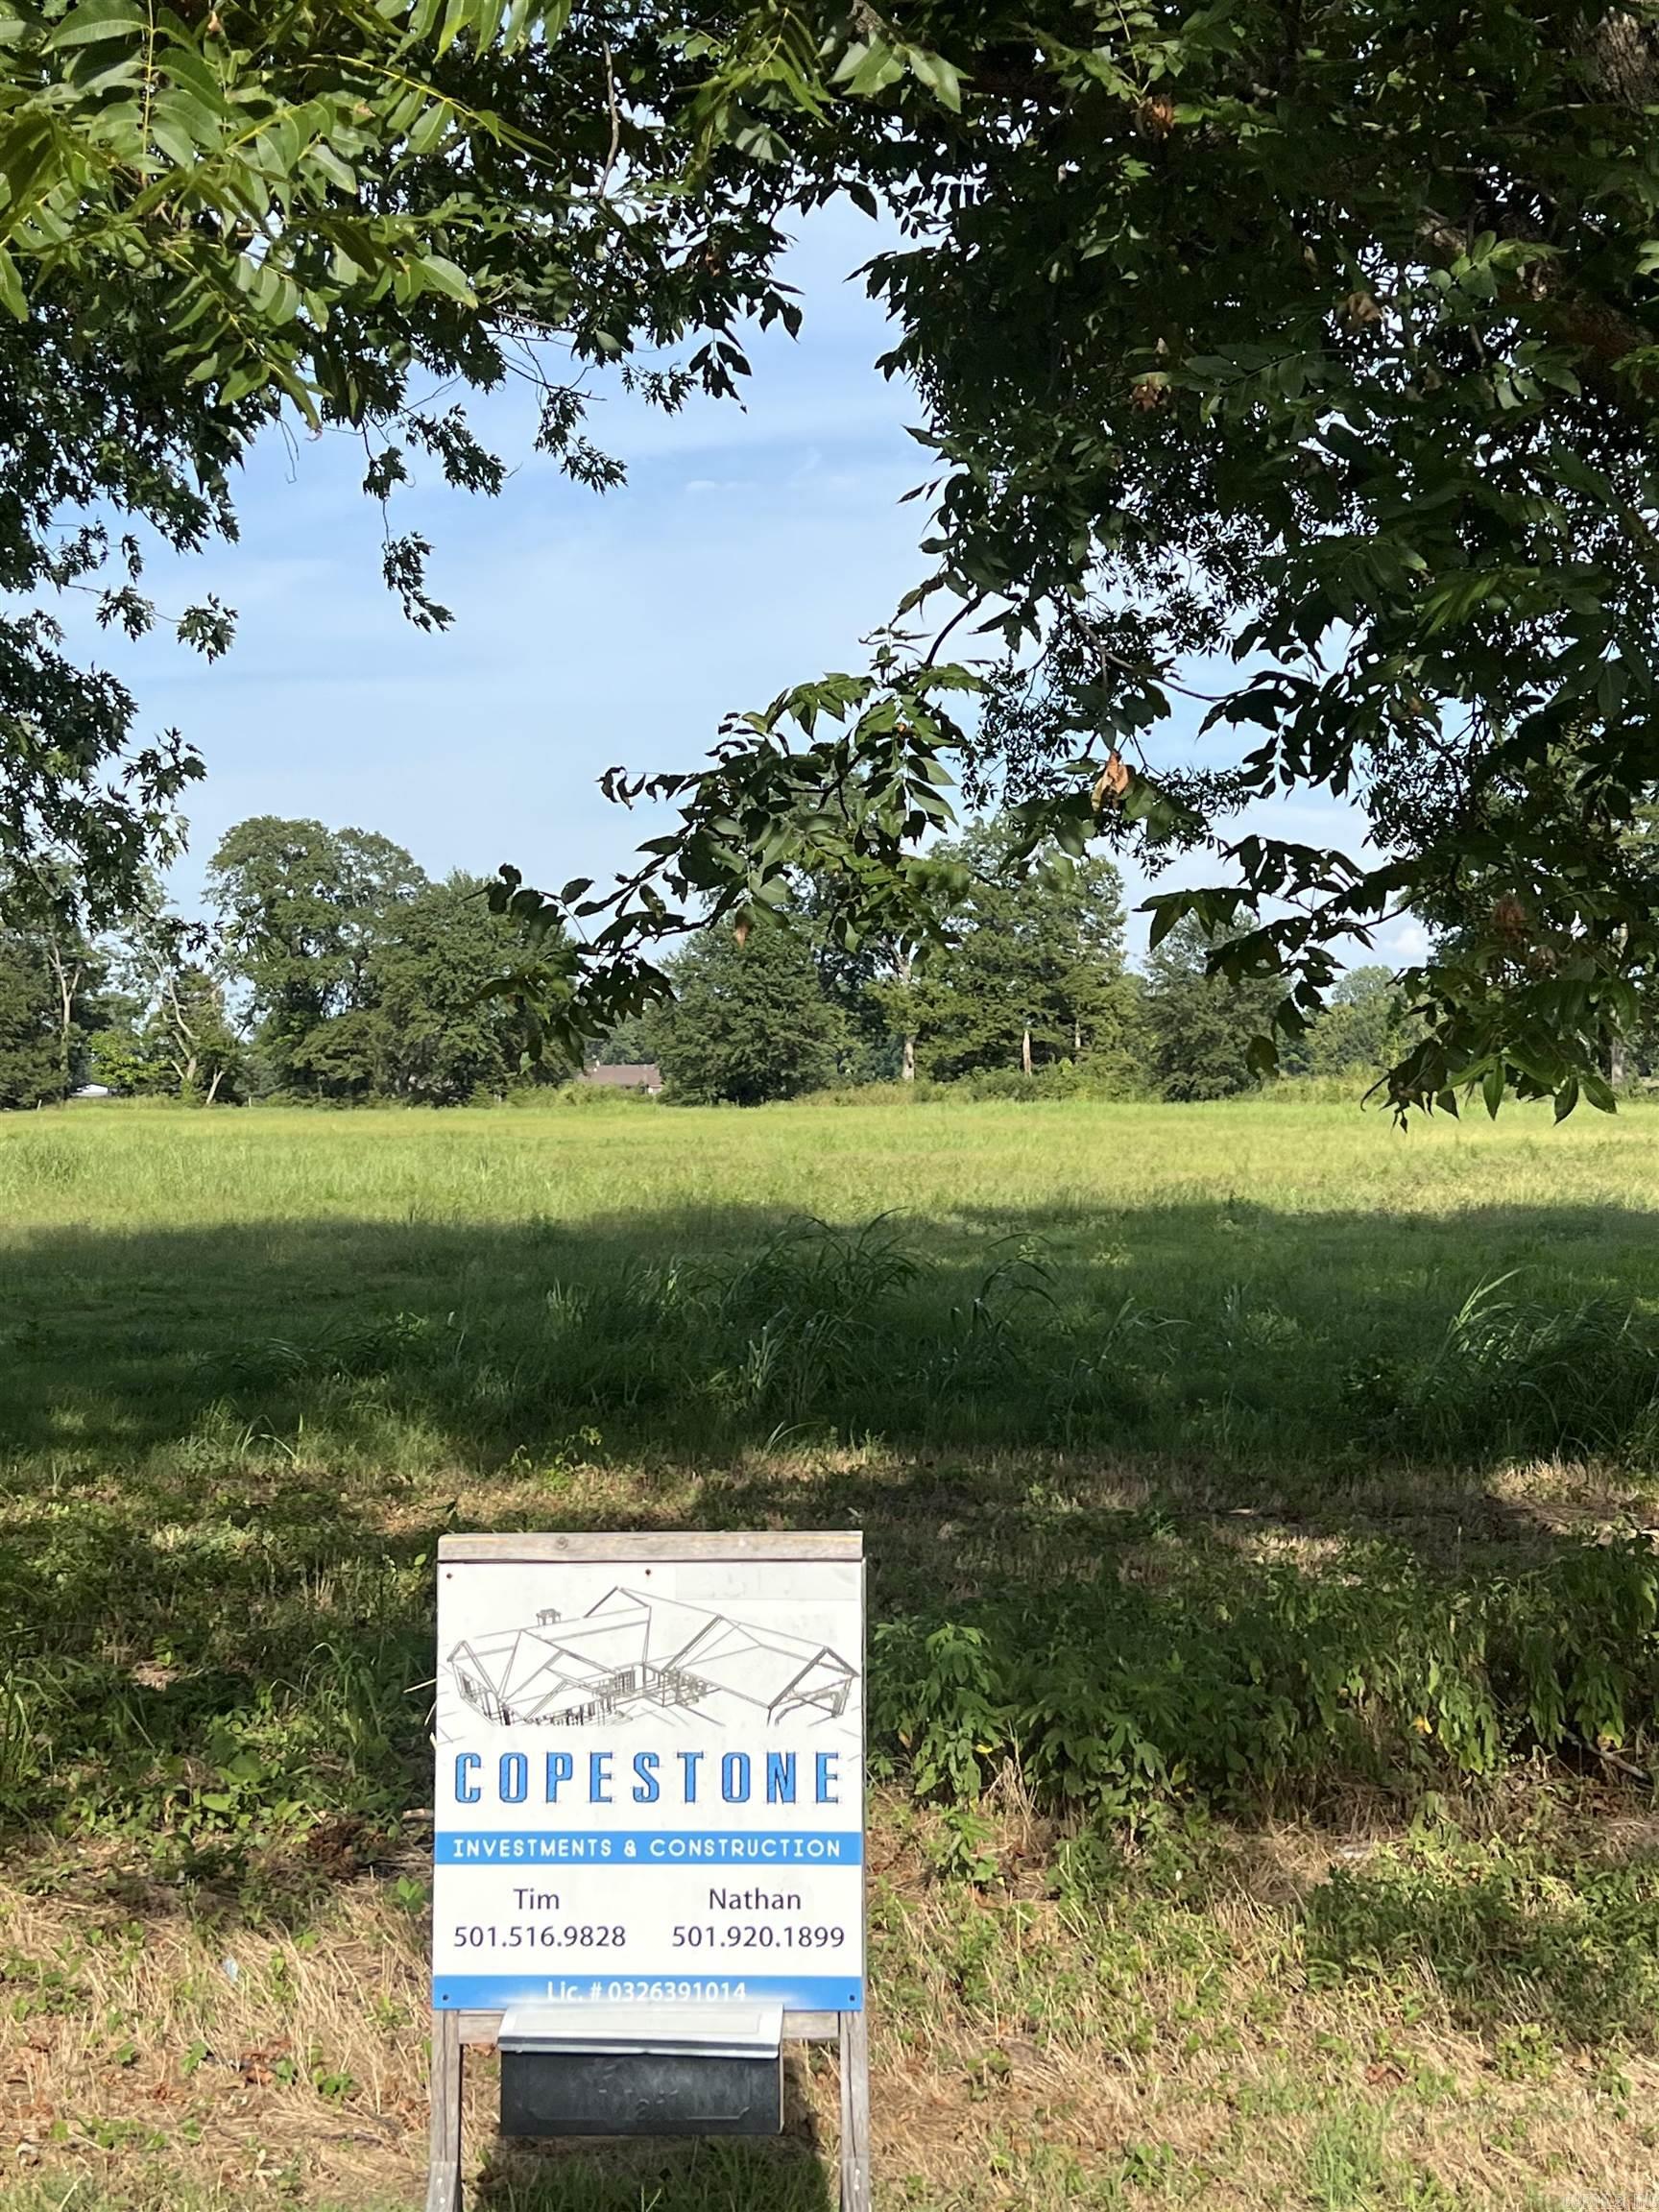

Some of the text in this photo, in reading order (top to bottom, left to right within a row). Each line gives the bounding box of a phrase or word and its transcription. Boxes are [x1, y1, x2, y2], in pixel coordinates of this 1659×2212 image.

[455, 1751, 840, 1804] COPESTONE
[453, 1839, 840, 1858] INVESTMENTS & CONSTRUCTION
[514, 1887, 560, 1911] Tim
[709, 1887, 802, 1911] Nathan
[453, 1925, 626, 1948] 501.516.9828
[672, 1925, 845, 1949] 501.920.1899
[547, 1981, 746, 2002] Lic. # 0326391014
